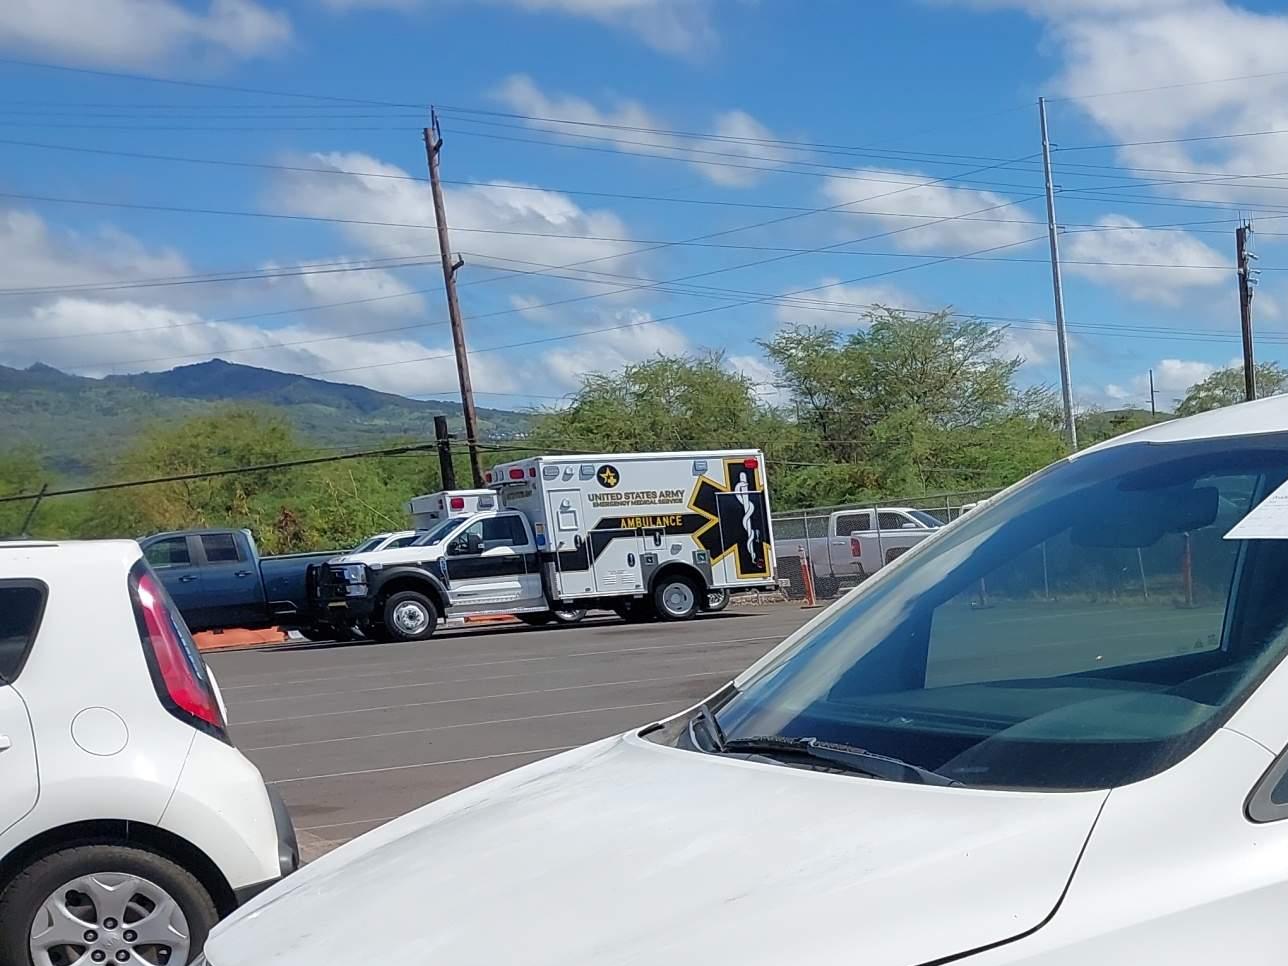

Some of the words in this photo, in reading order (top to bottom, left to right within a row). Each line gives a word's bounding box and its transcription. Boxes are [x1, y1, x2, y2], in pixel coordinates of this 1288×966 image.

[588, 493, 623, 502] UNITED
[624, 491, 657, 500] STATES
[659, 490, 685, 498] ARMY
[621, 516, 683, 529] AMBULANCE
